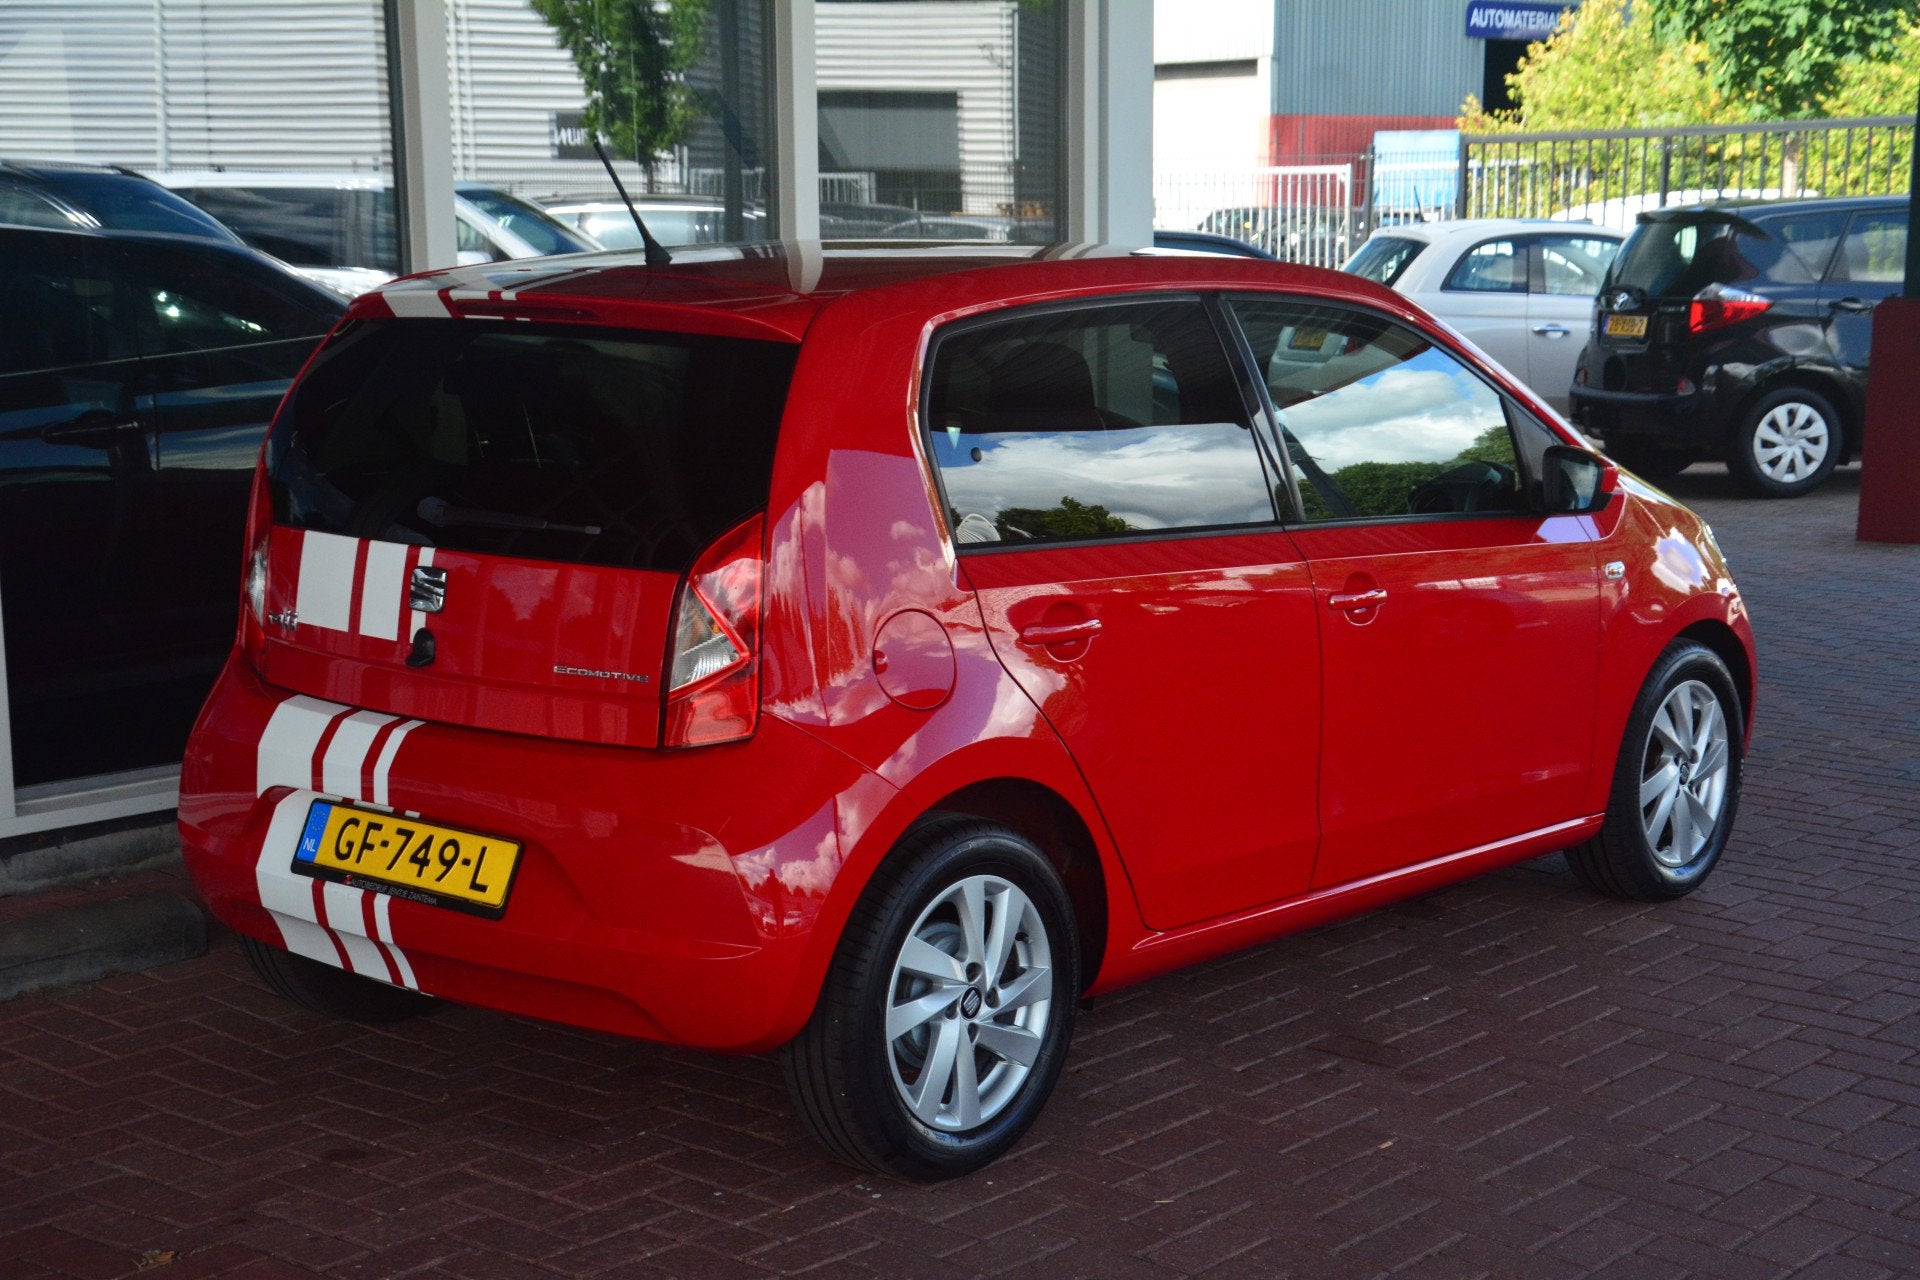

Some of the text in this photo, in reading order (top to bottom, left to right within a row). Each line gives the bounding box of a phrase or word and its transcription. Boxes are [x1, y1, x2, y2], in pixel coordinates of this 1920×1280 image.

[553, 665, 649, 683] ECOMOTIVE
[303, 837, 317, 852] NL
[334, 817, 489, 893] GF-749-L
